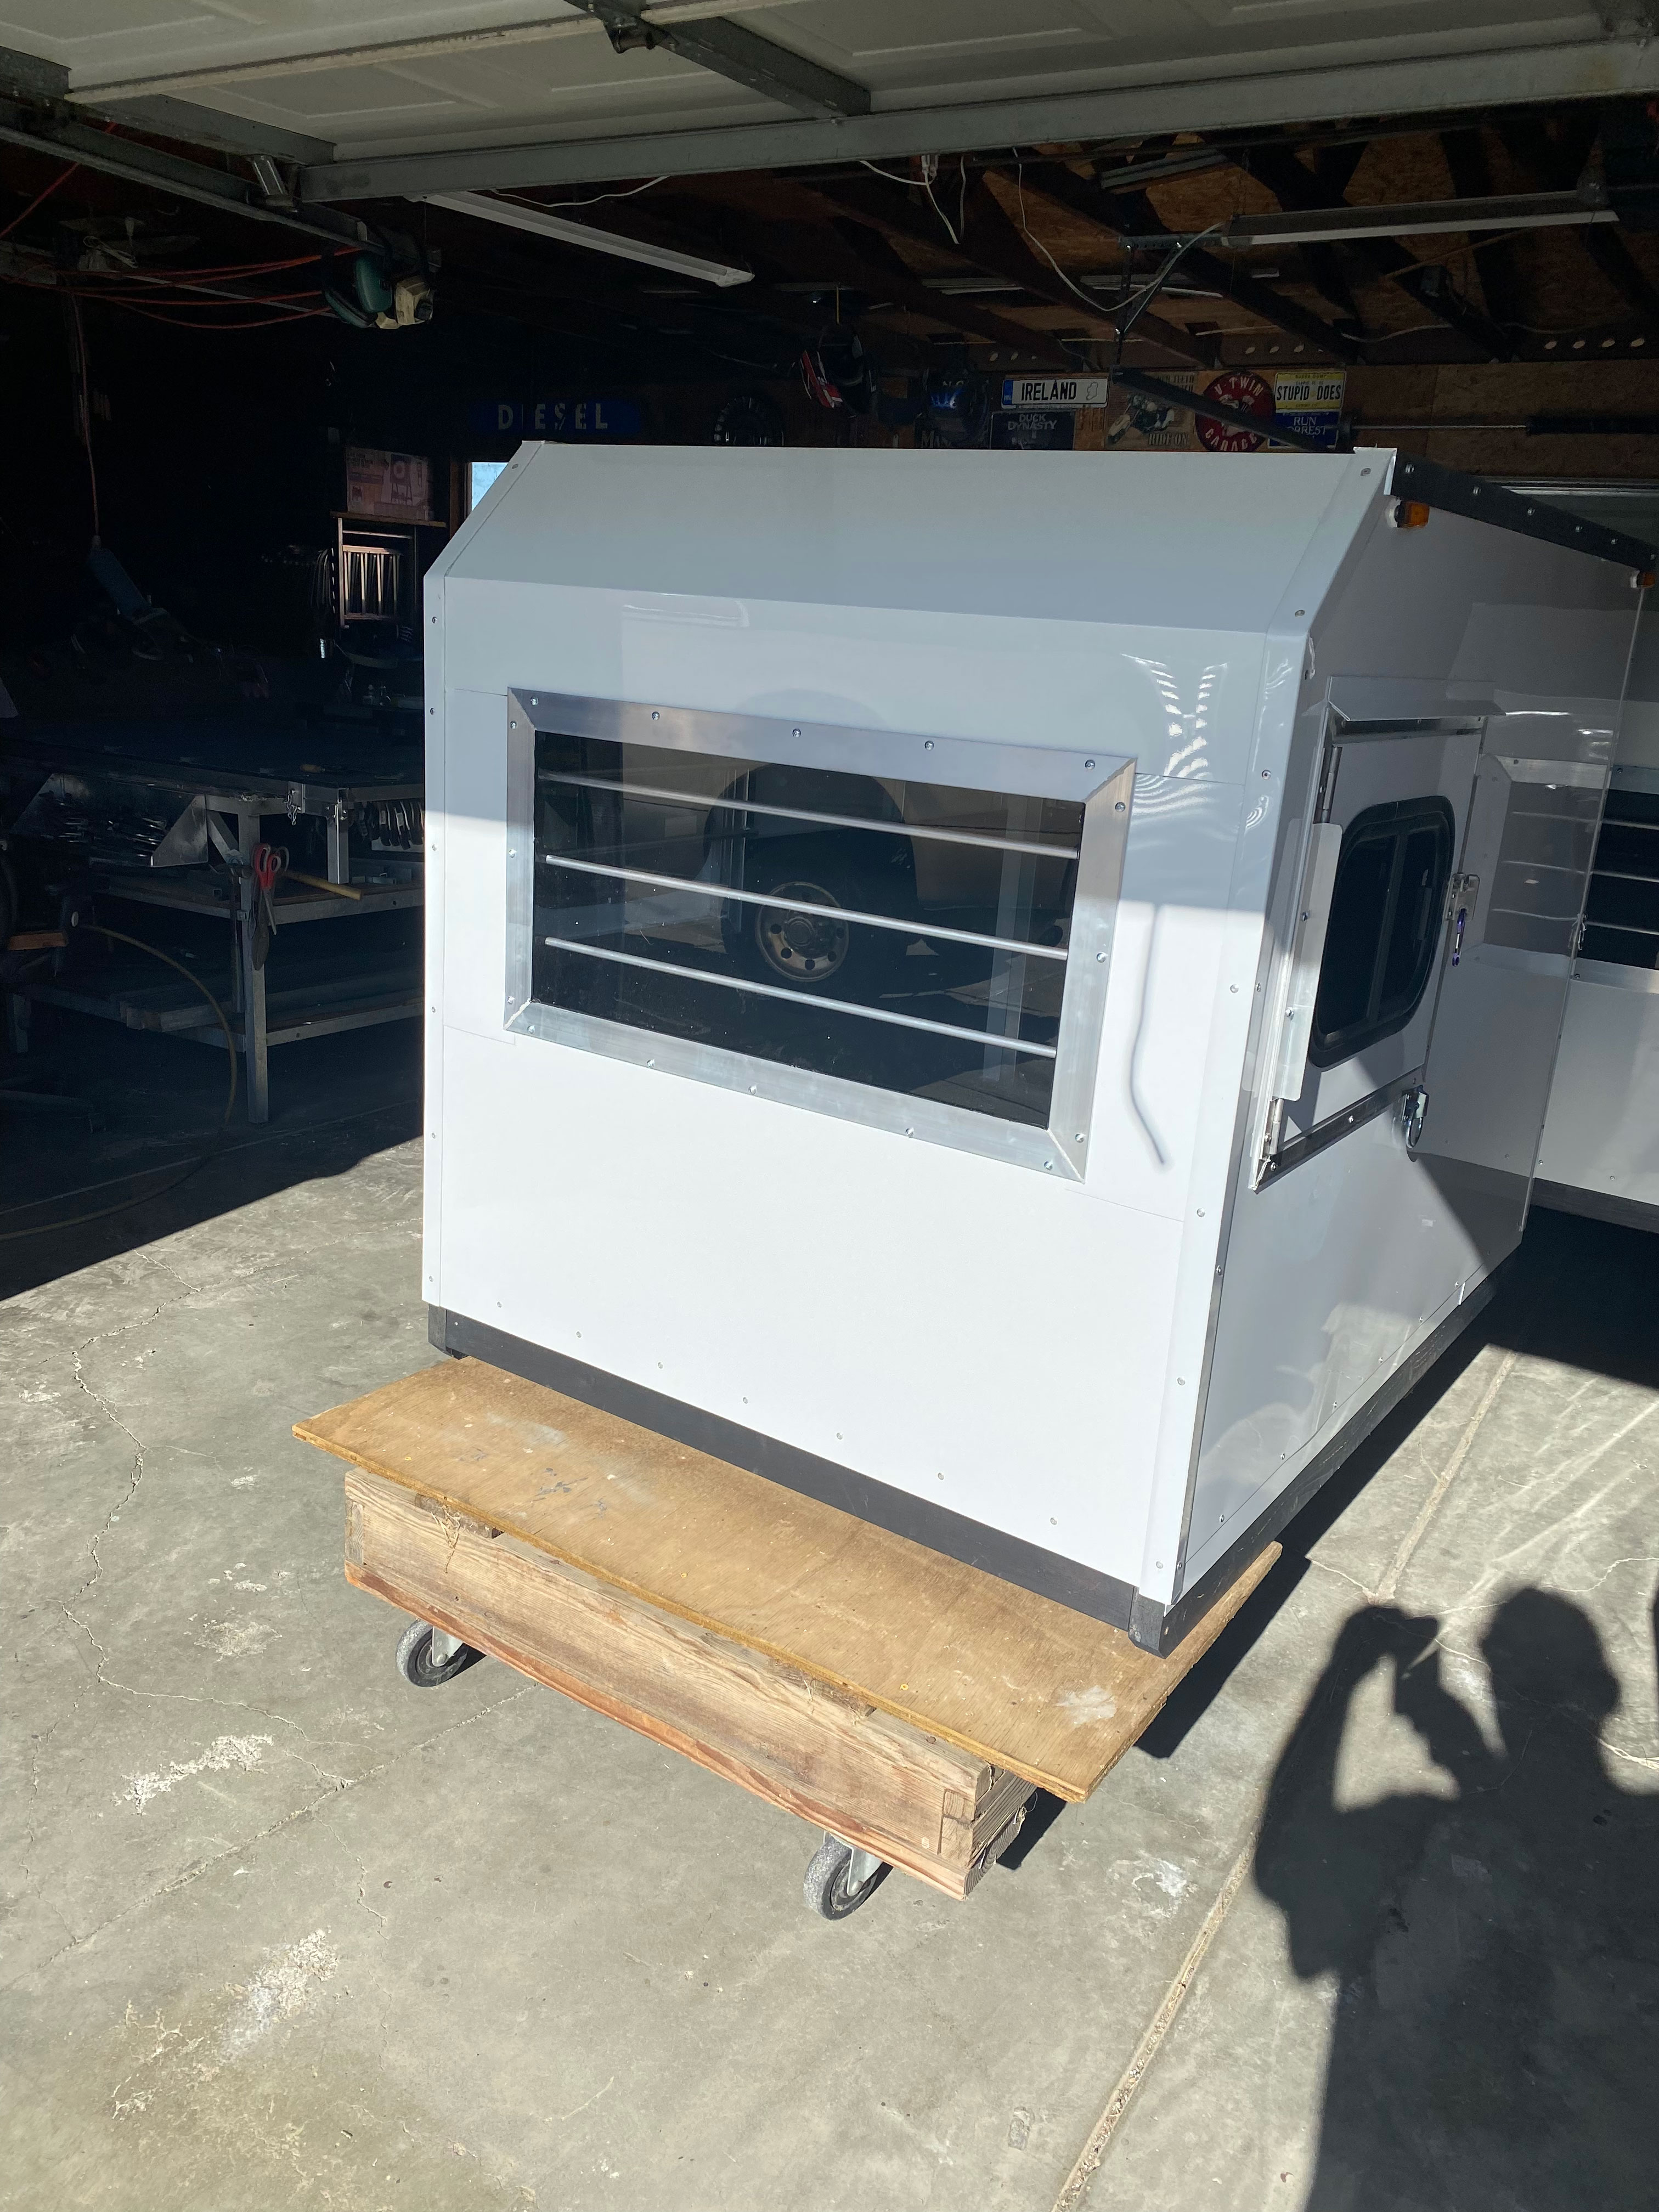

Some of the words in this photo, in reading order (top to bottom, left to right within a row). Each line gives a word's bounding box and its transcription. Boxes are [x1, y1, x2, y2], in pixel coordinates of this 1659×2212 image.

[1021, 382, 1077, 401] IRELAND
[1276, 385, 1310, 400] STUPID
[1317, 385, 1341, 400] DOES
[1019, 414, 1046, 422] DUCK
[1294, 416, 1317, 426] RUN
[1007, 420, 1058, 431] DYNASTY
[1286, 425, 1326, 435] RREST
[1148, 433, 1172, 445] RIDE
[1174, 434, 1190, 445] ON
